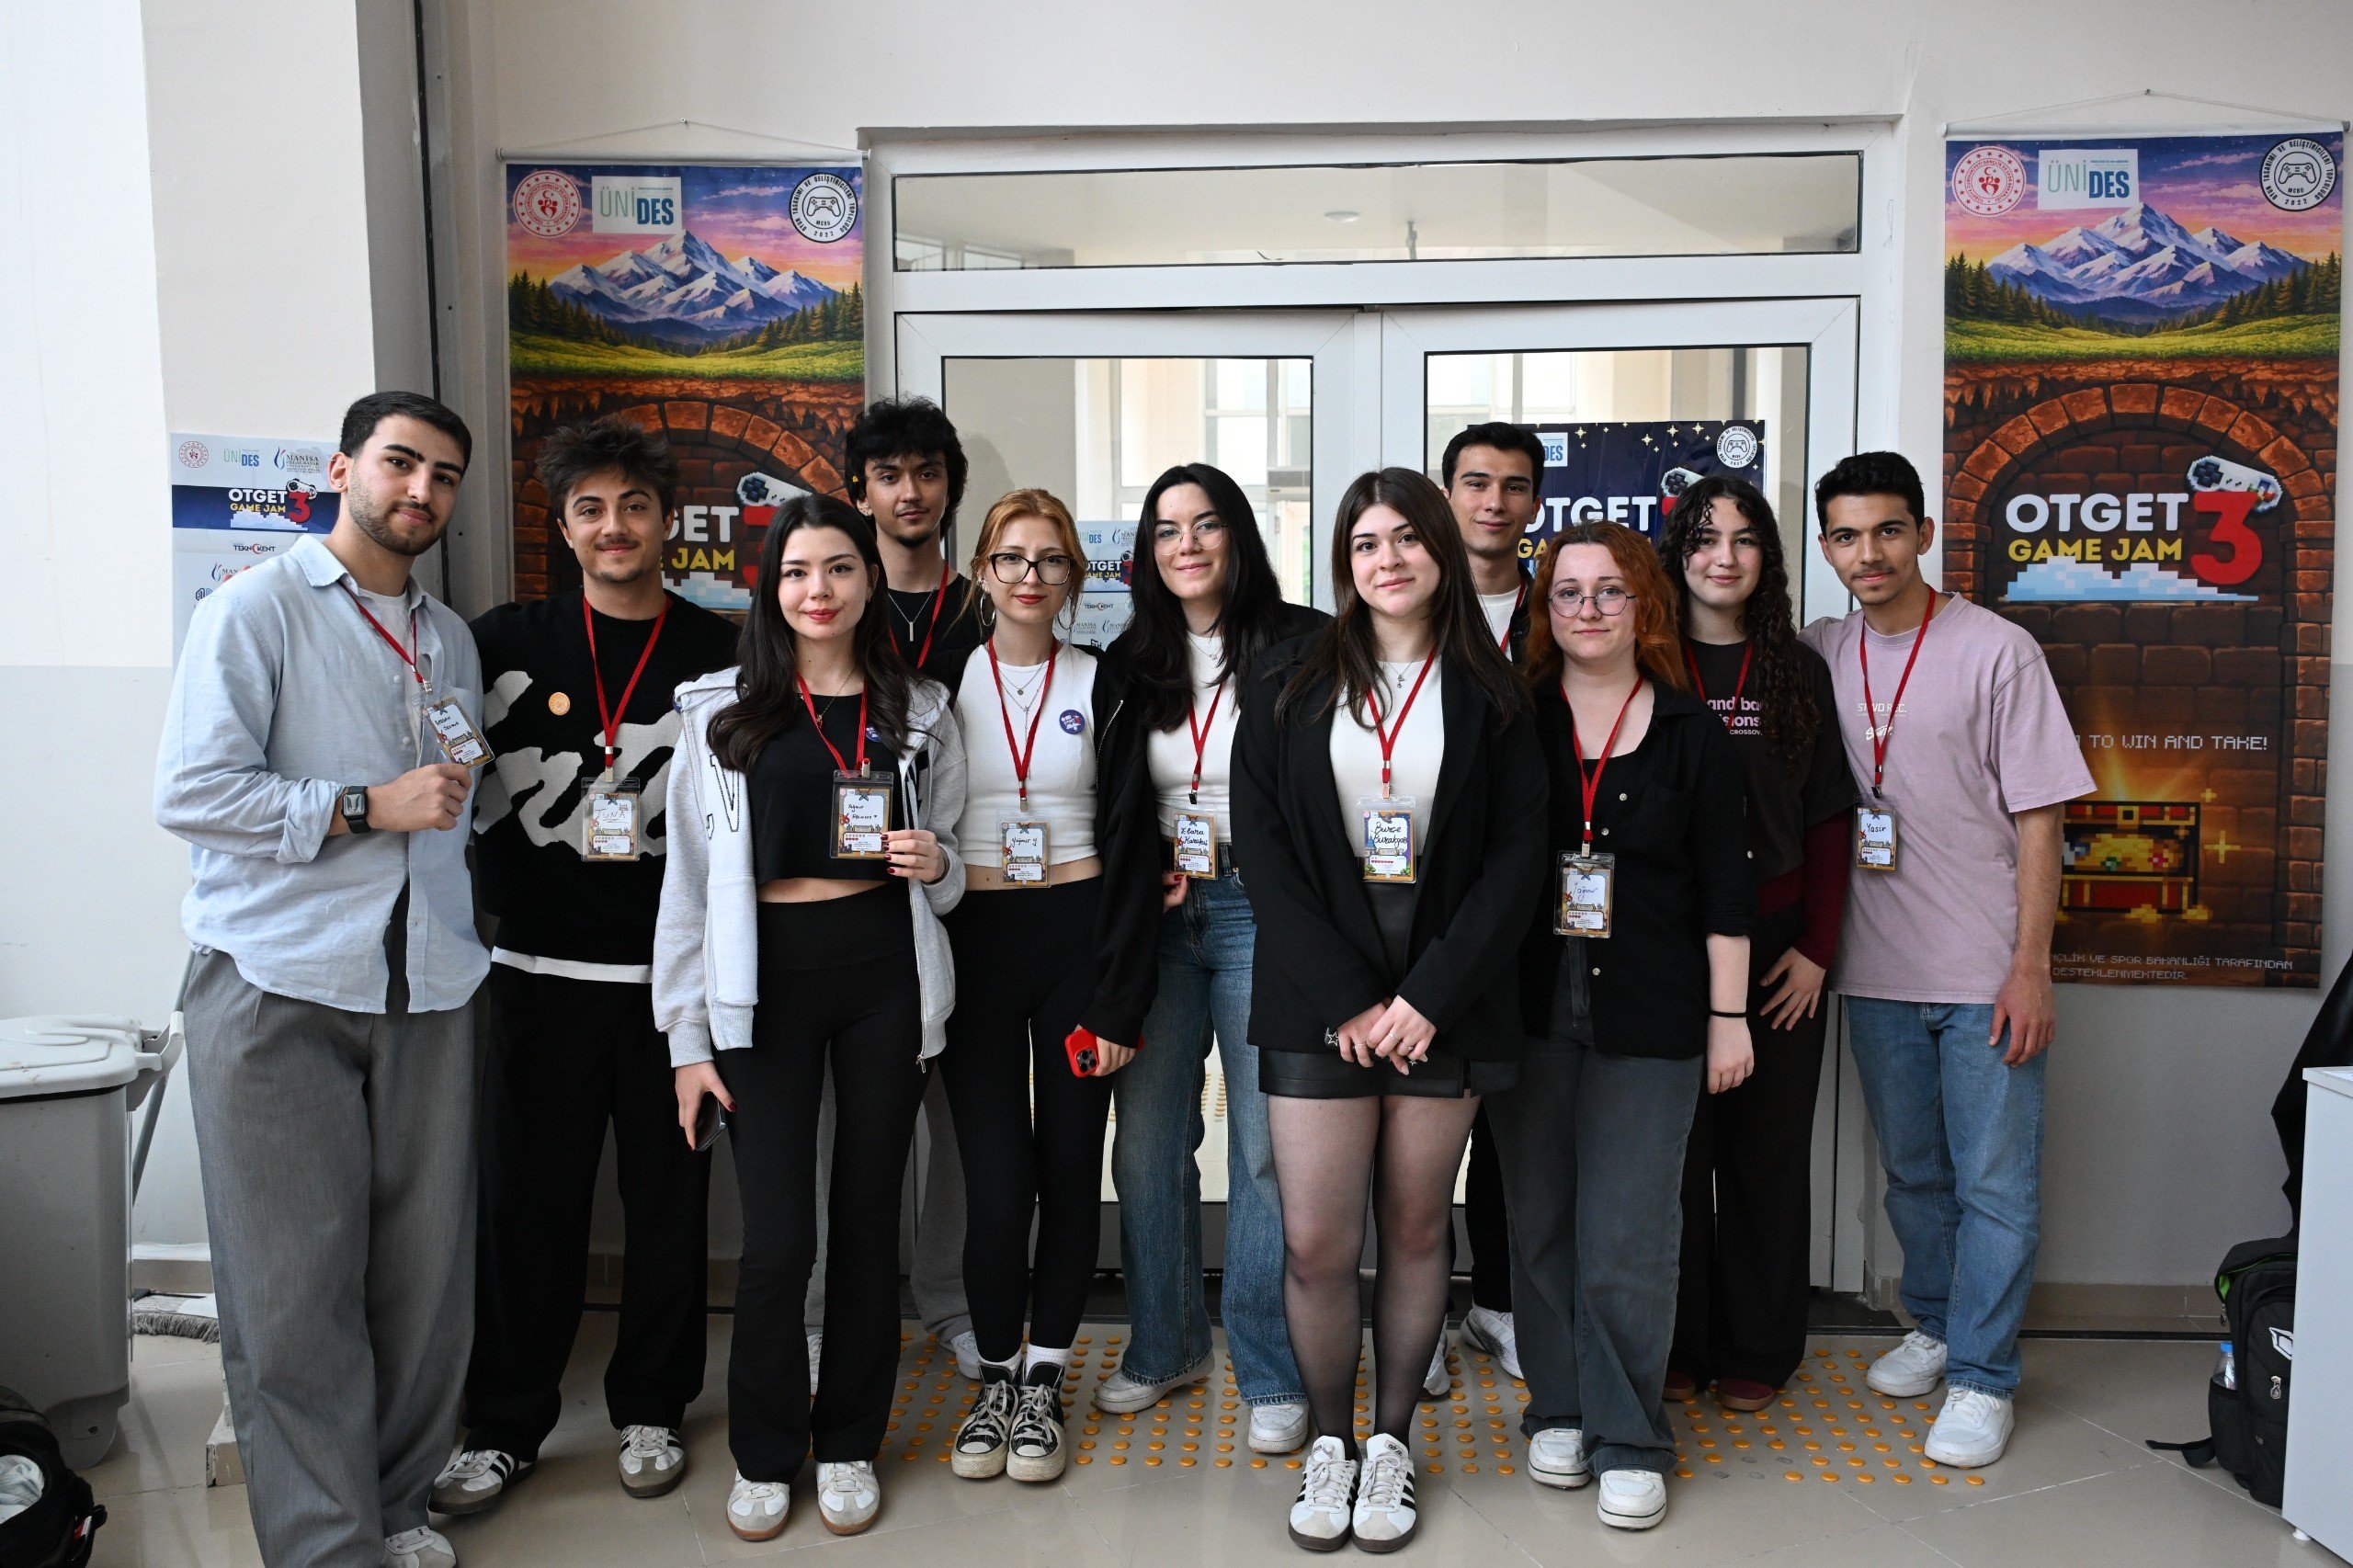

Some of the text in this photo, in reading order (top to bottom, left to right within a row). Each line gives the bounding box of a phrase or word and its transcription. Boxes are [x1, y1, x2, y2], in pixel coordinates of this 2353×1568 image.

[2284, 198, 2308, 206] 2022
[228, 488, 288, 504] OTGET
[230, 503, 286, 513] GAME JAM
[288, 492, 311, 523] 3
[2006, 493, 2189, 533] OTGET
[2189, 491, 2263, 585] 3
[2008, 538, 2183, 562] GAME JAM
[672, 548, 734, 571] JAM
[1887, 703, 1907, 712] RC.
[2088, 734, 2114, 748] TO
[2121, 734, 2157, 749] WIN
[2164, 735, 2203, 749] AND
[2211, 736, 2268, 750] TAKE!
[2089, 954, 2106, 963] VE
[2110, 955, 2142, 965] SPOR
[2215, 958, 2293, 970] TARAFINDAN
